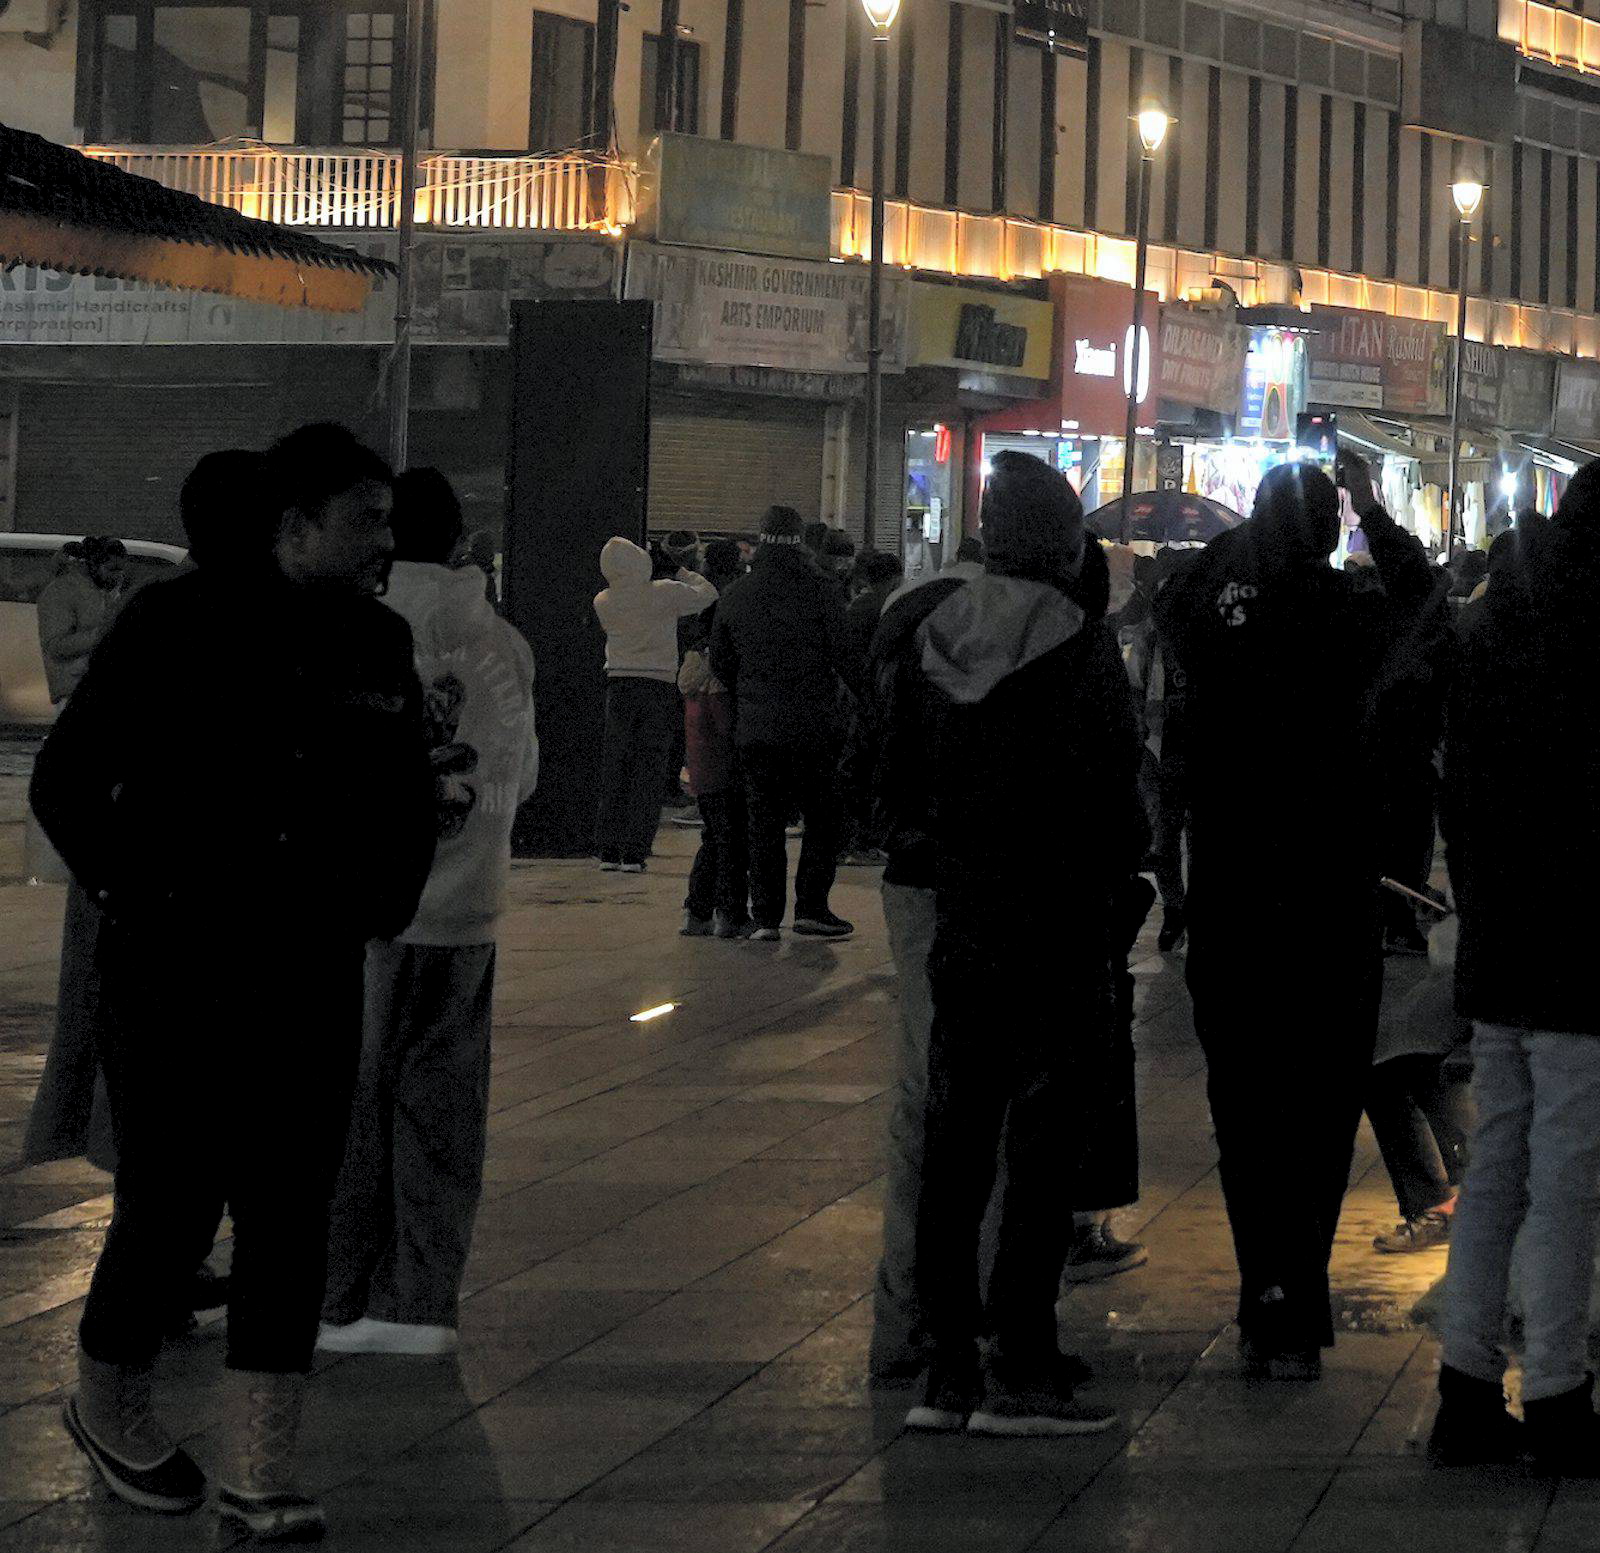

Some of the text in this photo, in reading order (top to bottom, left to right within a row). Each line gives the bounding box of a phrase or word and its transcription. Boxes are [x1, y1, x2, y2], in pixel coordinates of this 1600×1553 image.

[700, 260, 847, 300] KASHMIR GOVERNMENT
[76, 299, 188, 313] Handicrafts
[720, 301, 826, 333] ARTS EMPORIUM
[0, 318, 104, 333] orporation]
